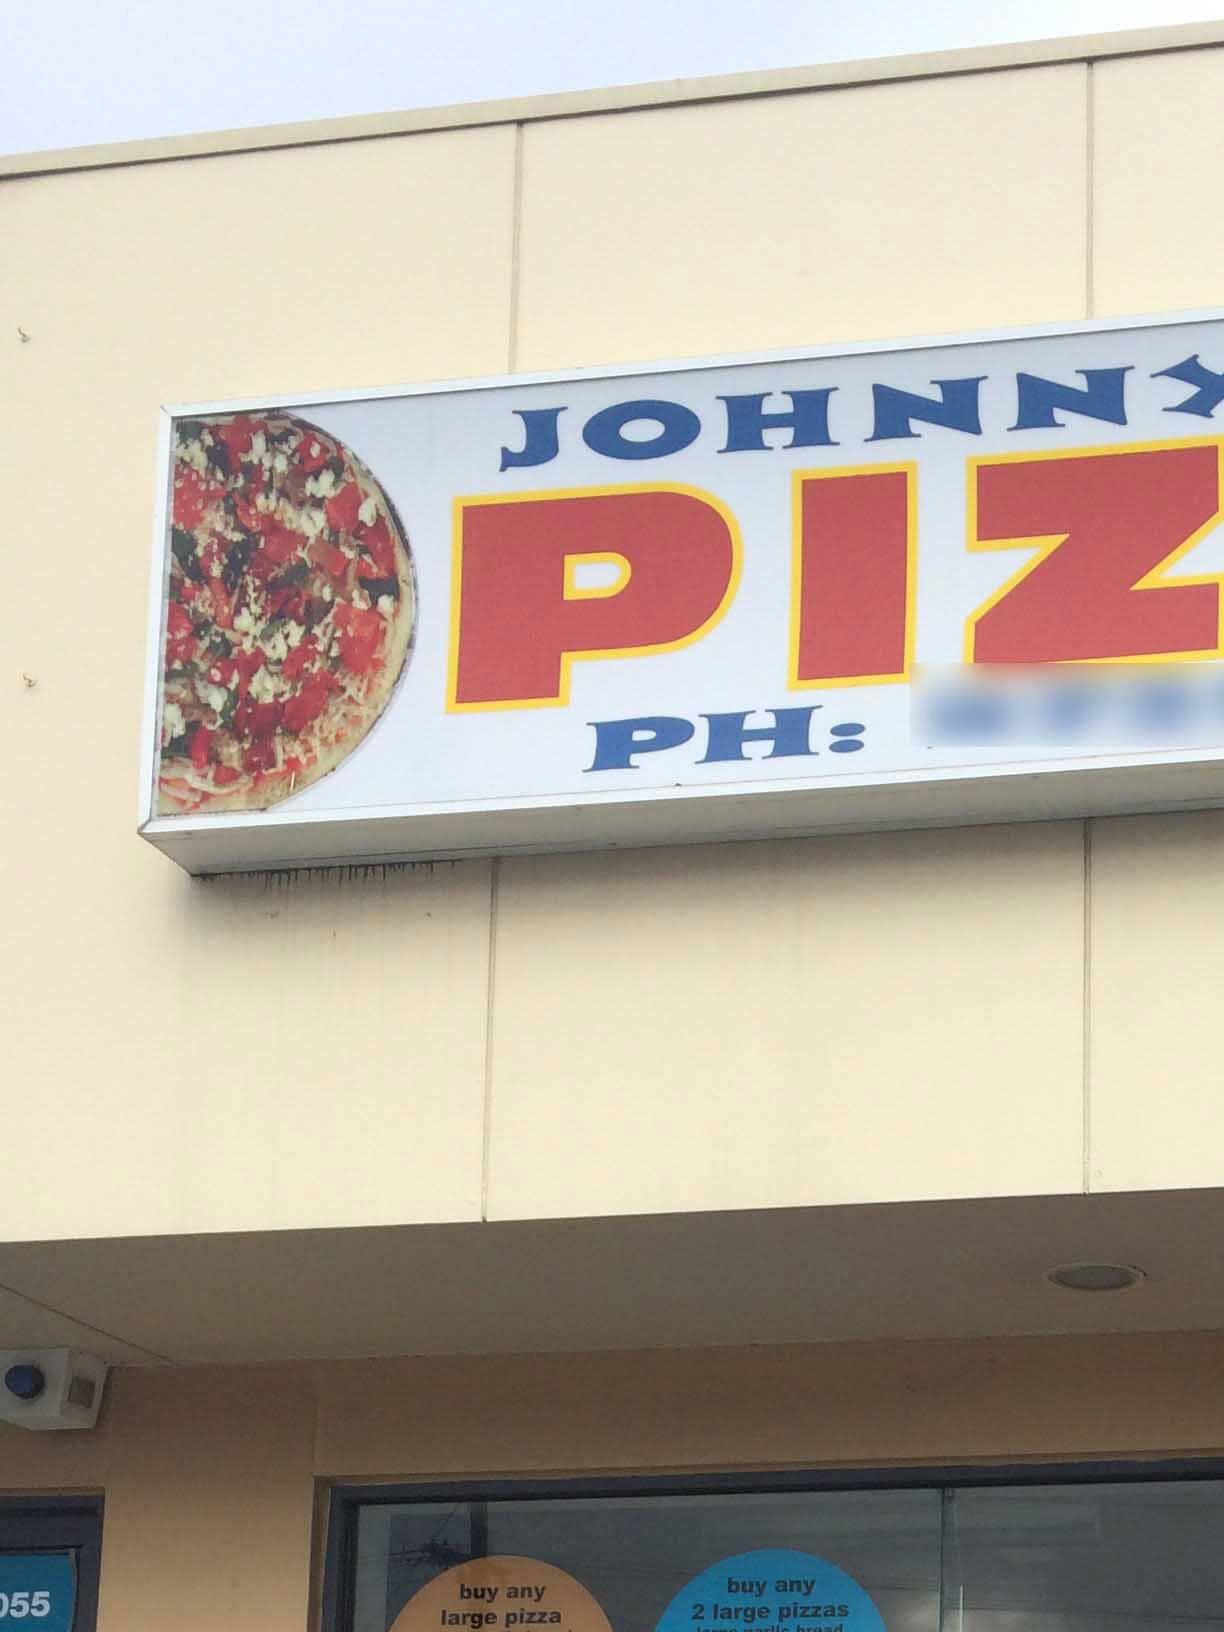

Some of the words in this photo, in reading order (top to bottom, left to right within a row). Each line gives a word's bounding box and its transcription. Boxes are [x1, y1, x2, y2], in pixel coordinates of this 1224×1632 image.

[583, 704, 866, 773] PH:
[459, 1583, 498, 1602] buy
[507, 1583, 546, 1602] any
[727, 1576, 766, 1597] buy
[774, 1577, 816, 1596] any
[441, 1609, 498, 1628] large
[504, 1608, 562, 1627] pizza
[691, 1603, 705, 1619] 2
[713, 1602, 772, 1623] large
[778, 1602, 849, 1621] pizzas
